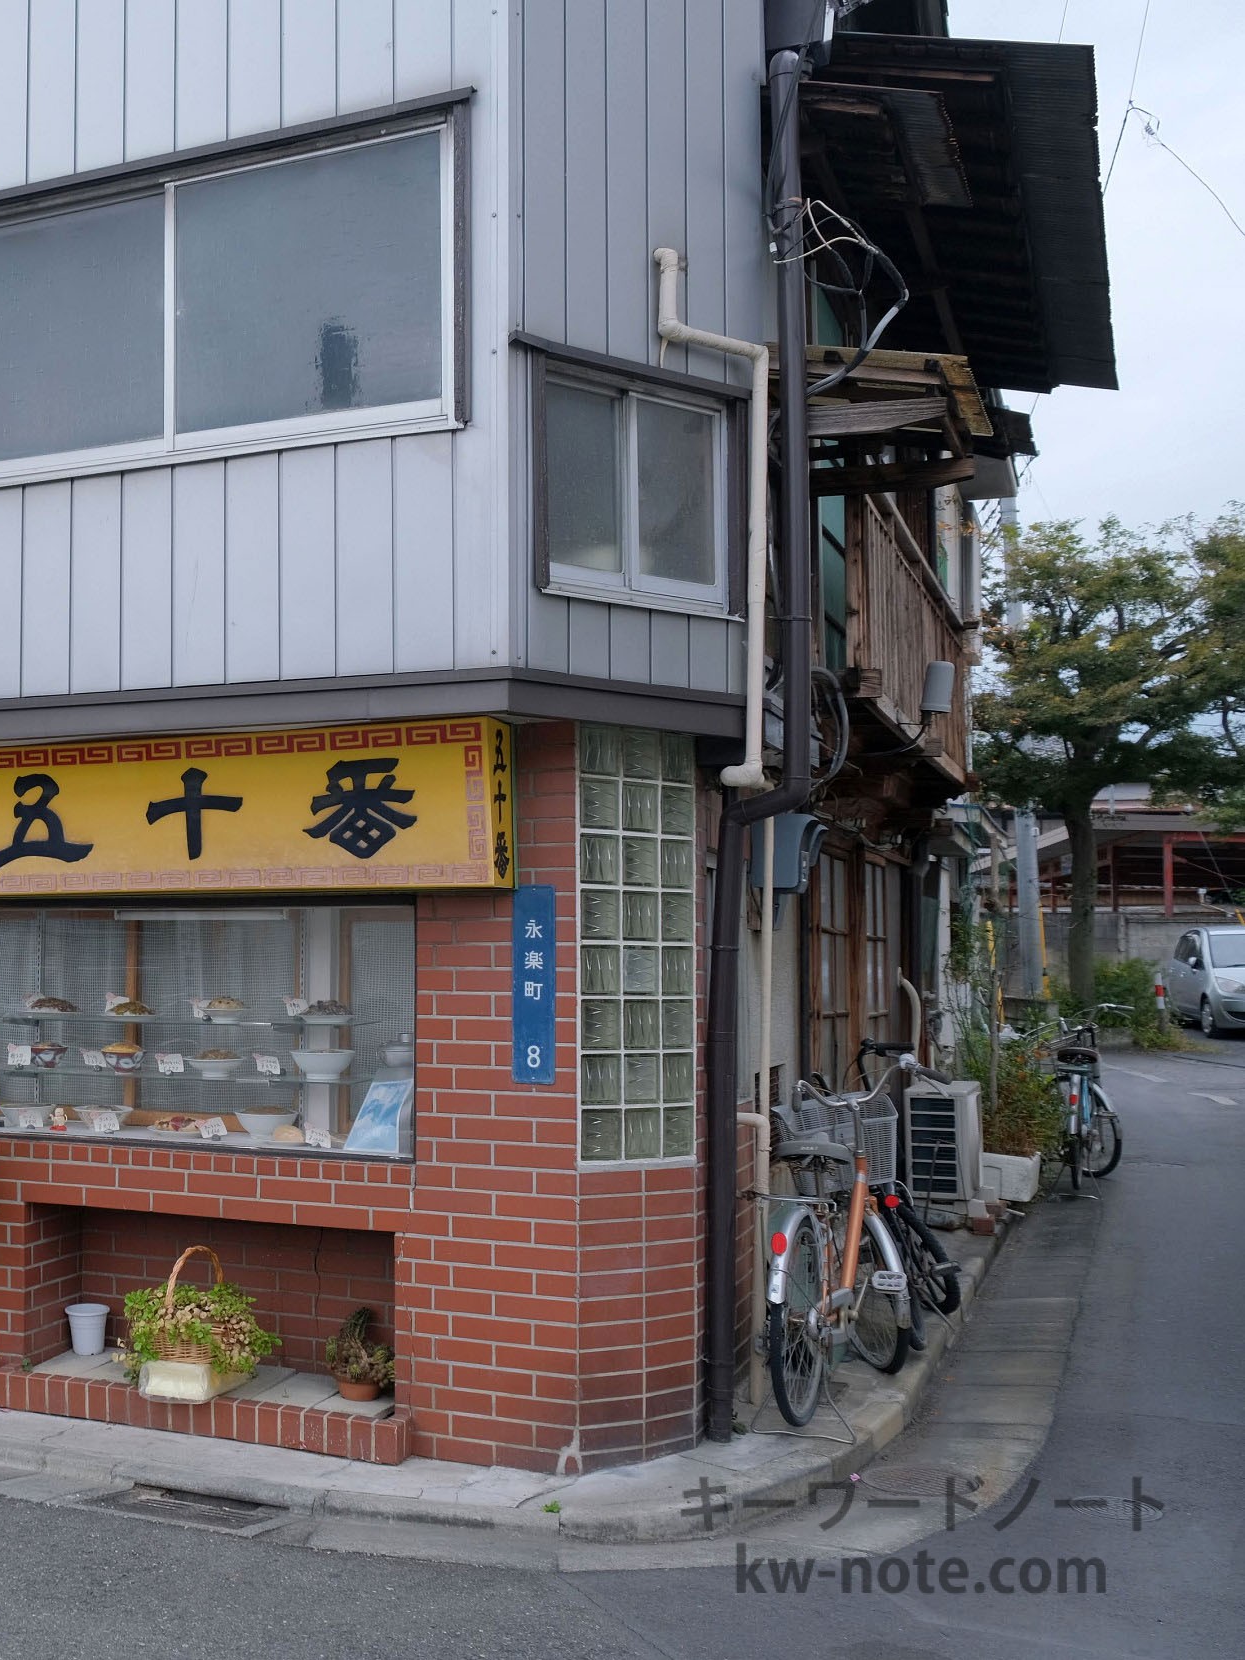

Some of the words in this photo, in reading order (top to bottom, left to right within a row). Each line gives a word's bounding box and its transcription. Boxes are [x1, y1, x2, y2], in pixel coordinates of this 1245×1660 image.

[493, 728, 510, 880] 五十番
[524, 919, 544, 1001] 永楽町
[527, 1045, 541, 1068] 8
